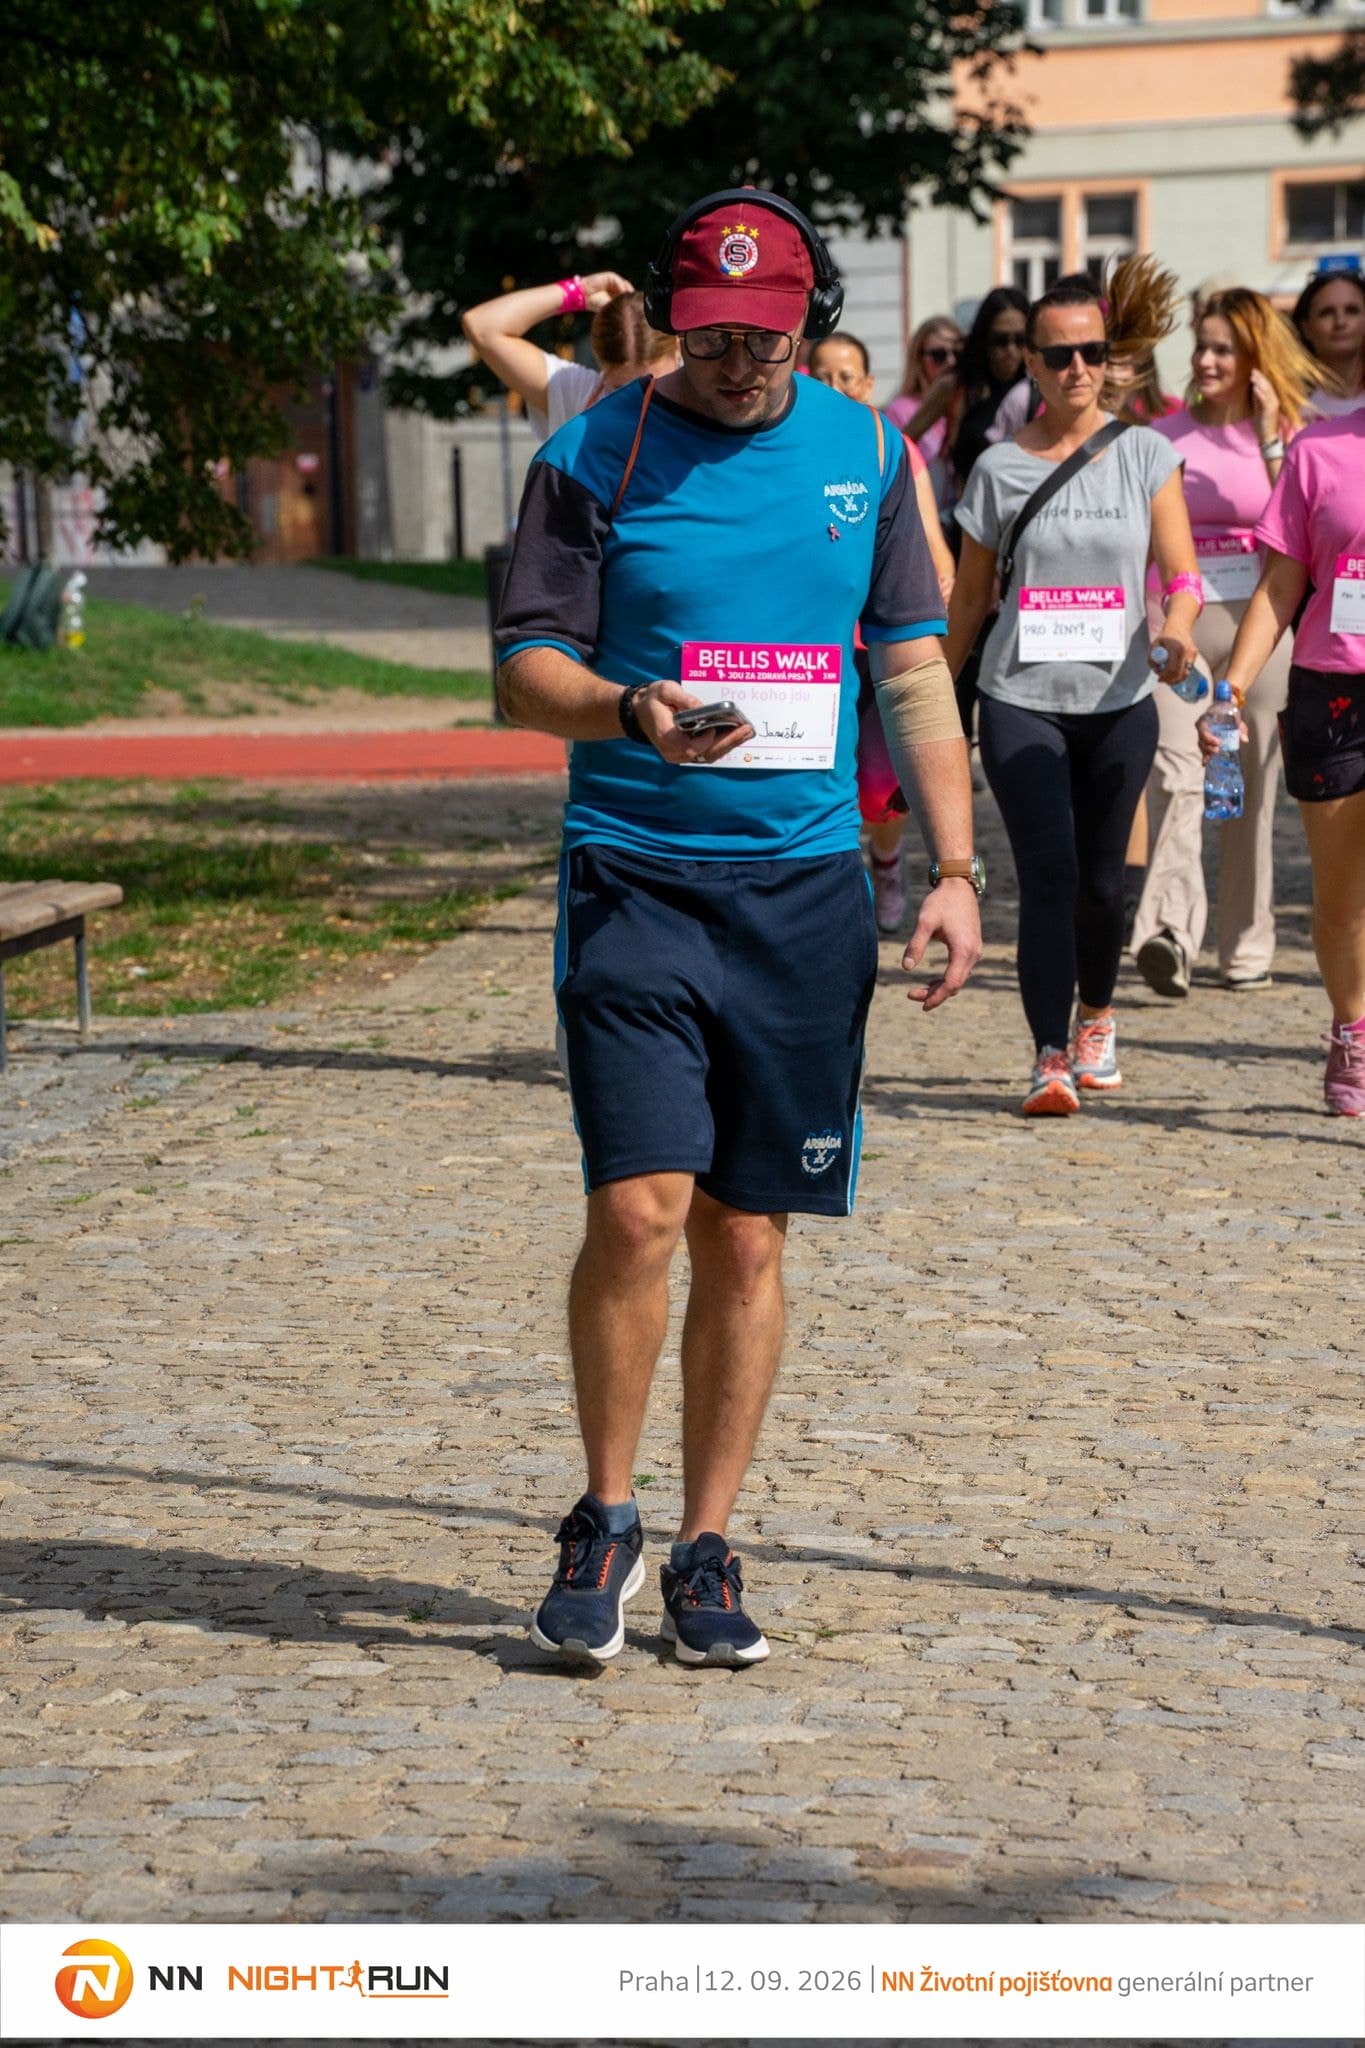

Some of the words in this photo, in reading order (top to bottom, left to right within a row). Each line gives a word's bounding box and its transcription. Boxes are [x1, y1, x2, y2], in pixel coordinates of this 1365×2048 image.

[1028, 590, 1073, 603] BELLIS
[1075, 589, 1116, 602] WALK
[698, 649, 769, 669] BELLIS
[775, 651, 829, 671] WALK
